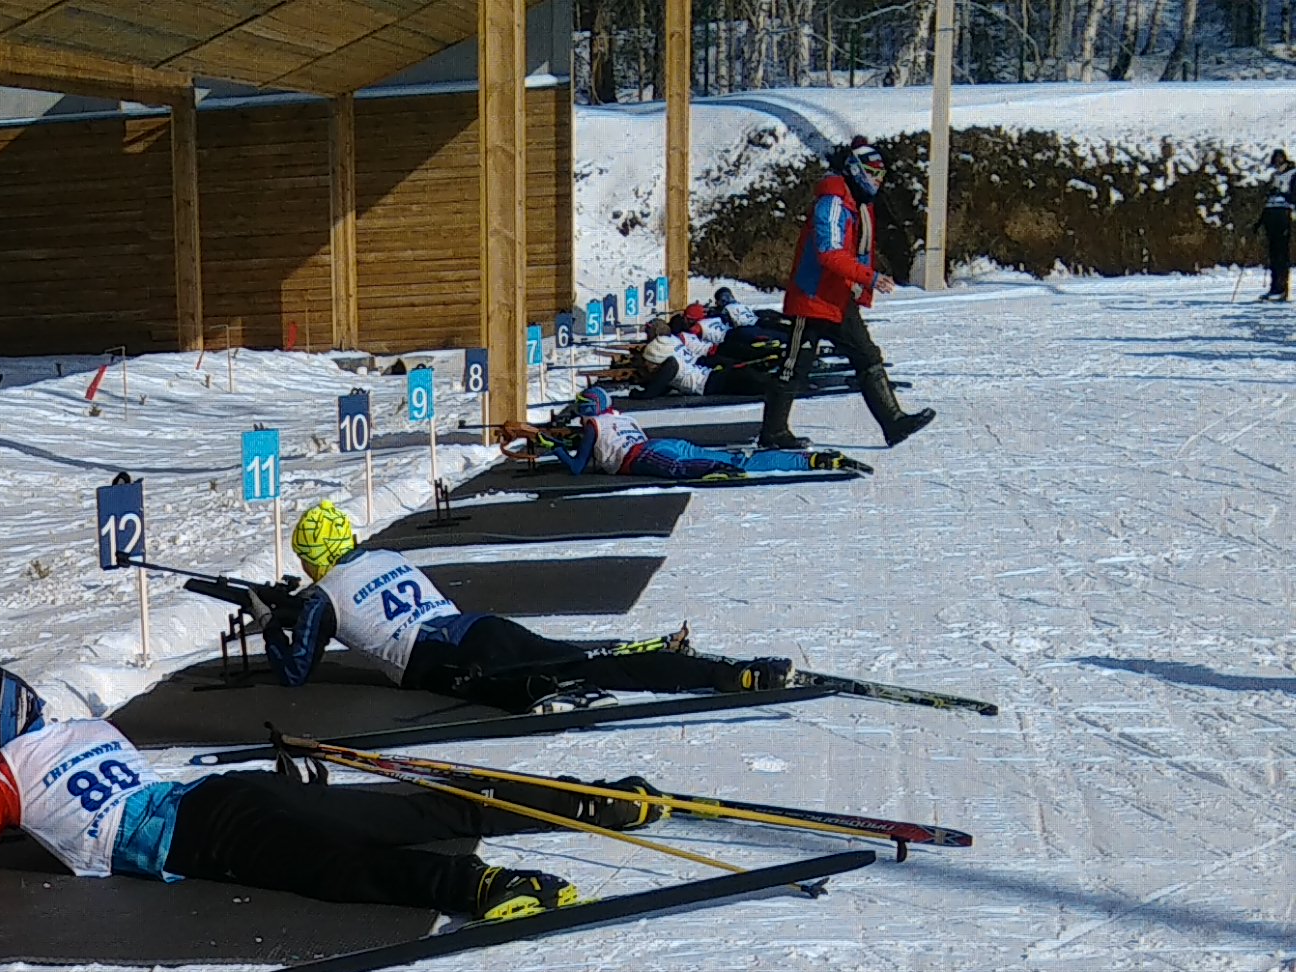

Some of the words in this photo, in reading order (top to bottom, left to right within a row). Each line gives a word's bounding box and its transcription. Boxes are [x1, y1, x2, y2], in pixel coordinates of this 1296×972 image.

[627, 298, 636, 315] 3
[646, 290, 655, 307] 2
[588, 314, 599, 333] 5
[605, 307, 615, 326] 4
[558, 326, 569, 347] 6
[527, 340, 537, 363] 7
[469, 364, 483, 391] 8
[412, 387, 428, 419] 9
[340, 414, 368, 451] 10
[247, 455, 276, 494] 11
[100, 512, 143, 564] 12
[382, 580, 422, 622] 42
[67, 760, 142, 812] 80
